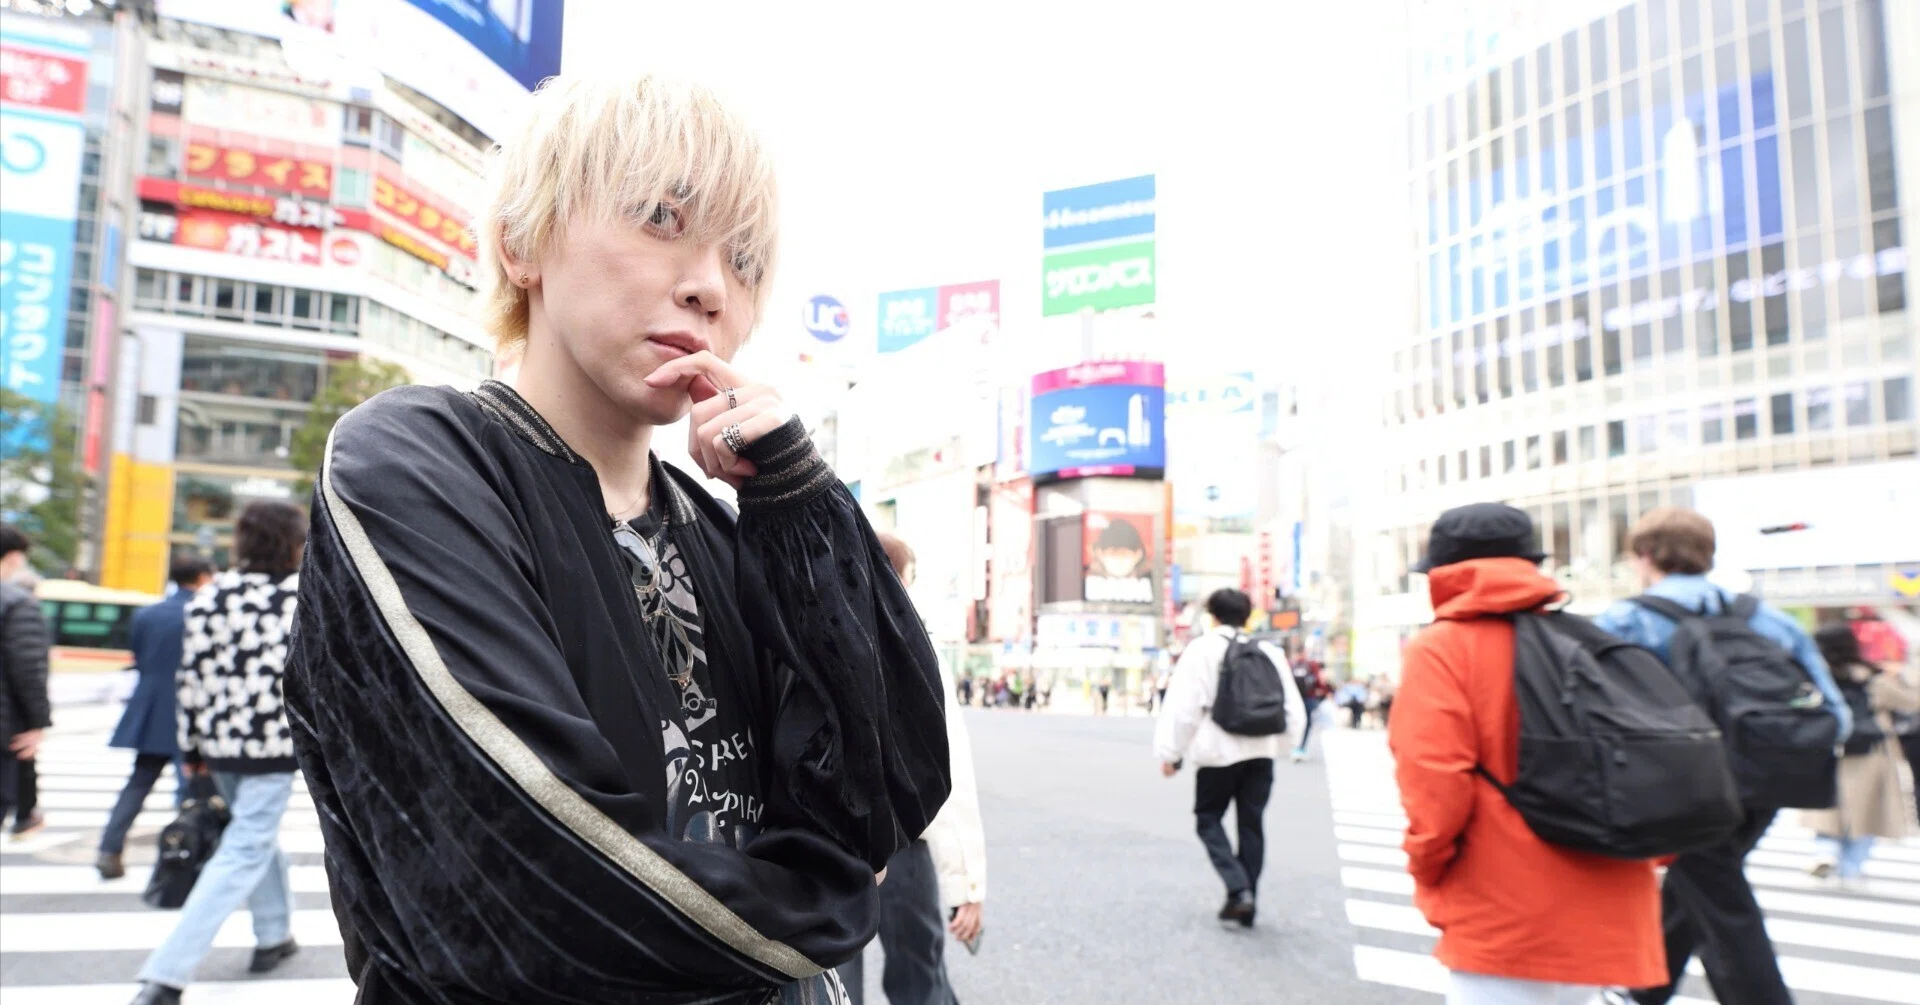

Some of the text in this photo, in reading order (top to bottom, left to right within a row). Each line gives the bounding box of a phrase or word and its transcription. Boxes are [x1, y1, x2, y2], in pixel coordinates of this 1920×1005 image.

[228, 225, 318, 264] ガスト
[1046, 257, 1153, 298] サロンパス
[10, 242, 56, 388] コンタクト
[805, 302, 850, 334] UC
